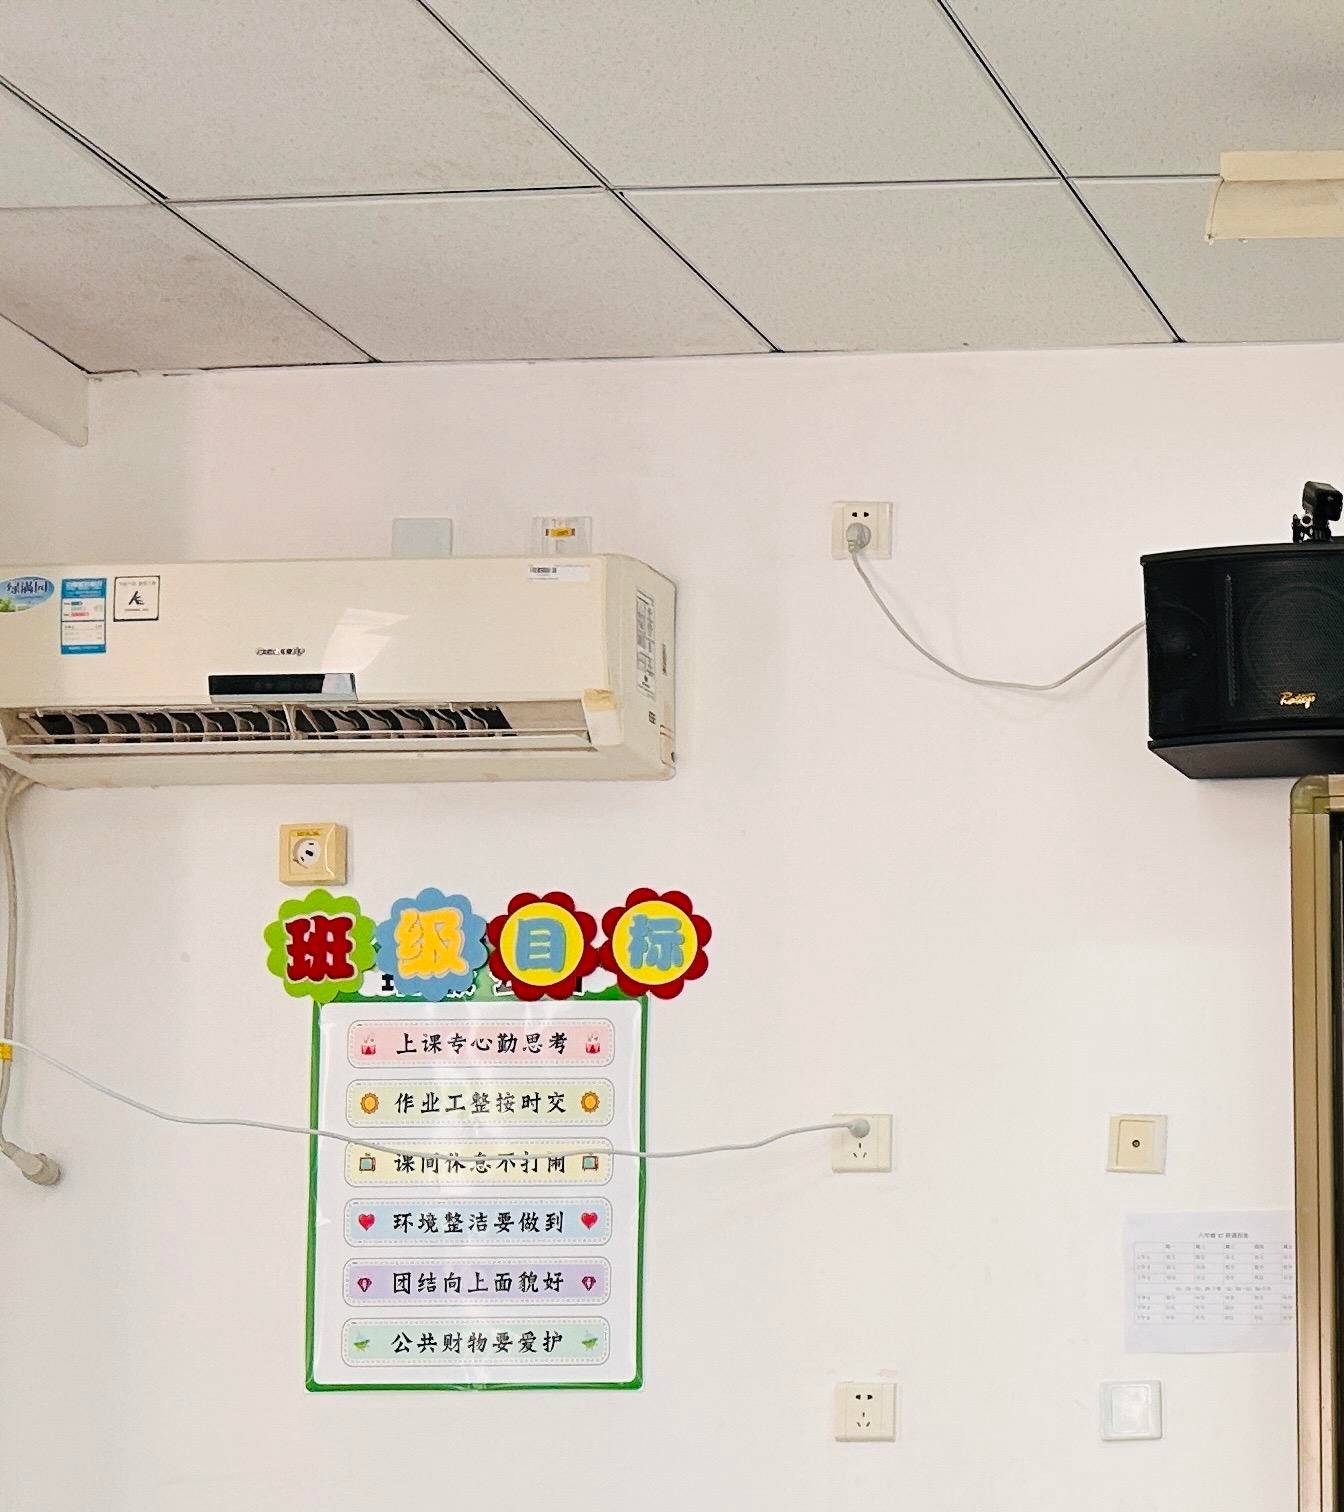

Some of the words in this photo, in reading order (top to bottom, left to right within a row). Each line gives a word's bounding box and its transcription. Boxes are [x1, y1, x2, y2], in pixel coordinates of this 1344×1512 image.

[284, 907, 687, 982] 班级目标
[395, 1031, 569, 1056] 上课专心勤思考
[394, 1092, 568, 1115] 作业工整按时交
[393, 1150, 567, 1175] 课间休息不打闹
[392, 1211, 566, 1235] 环境整洁要做到
[392, 1270, 566, 1295] 团结向上面貌好
[391, 1330, 564, 1355] 公共财物要爱护
